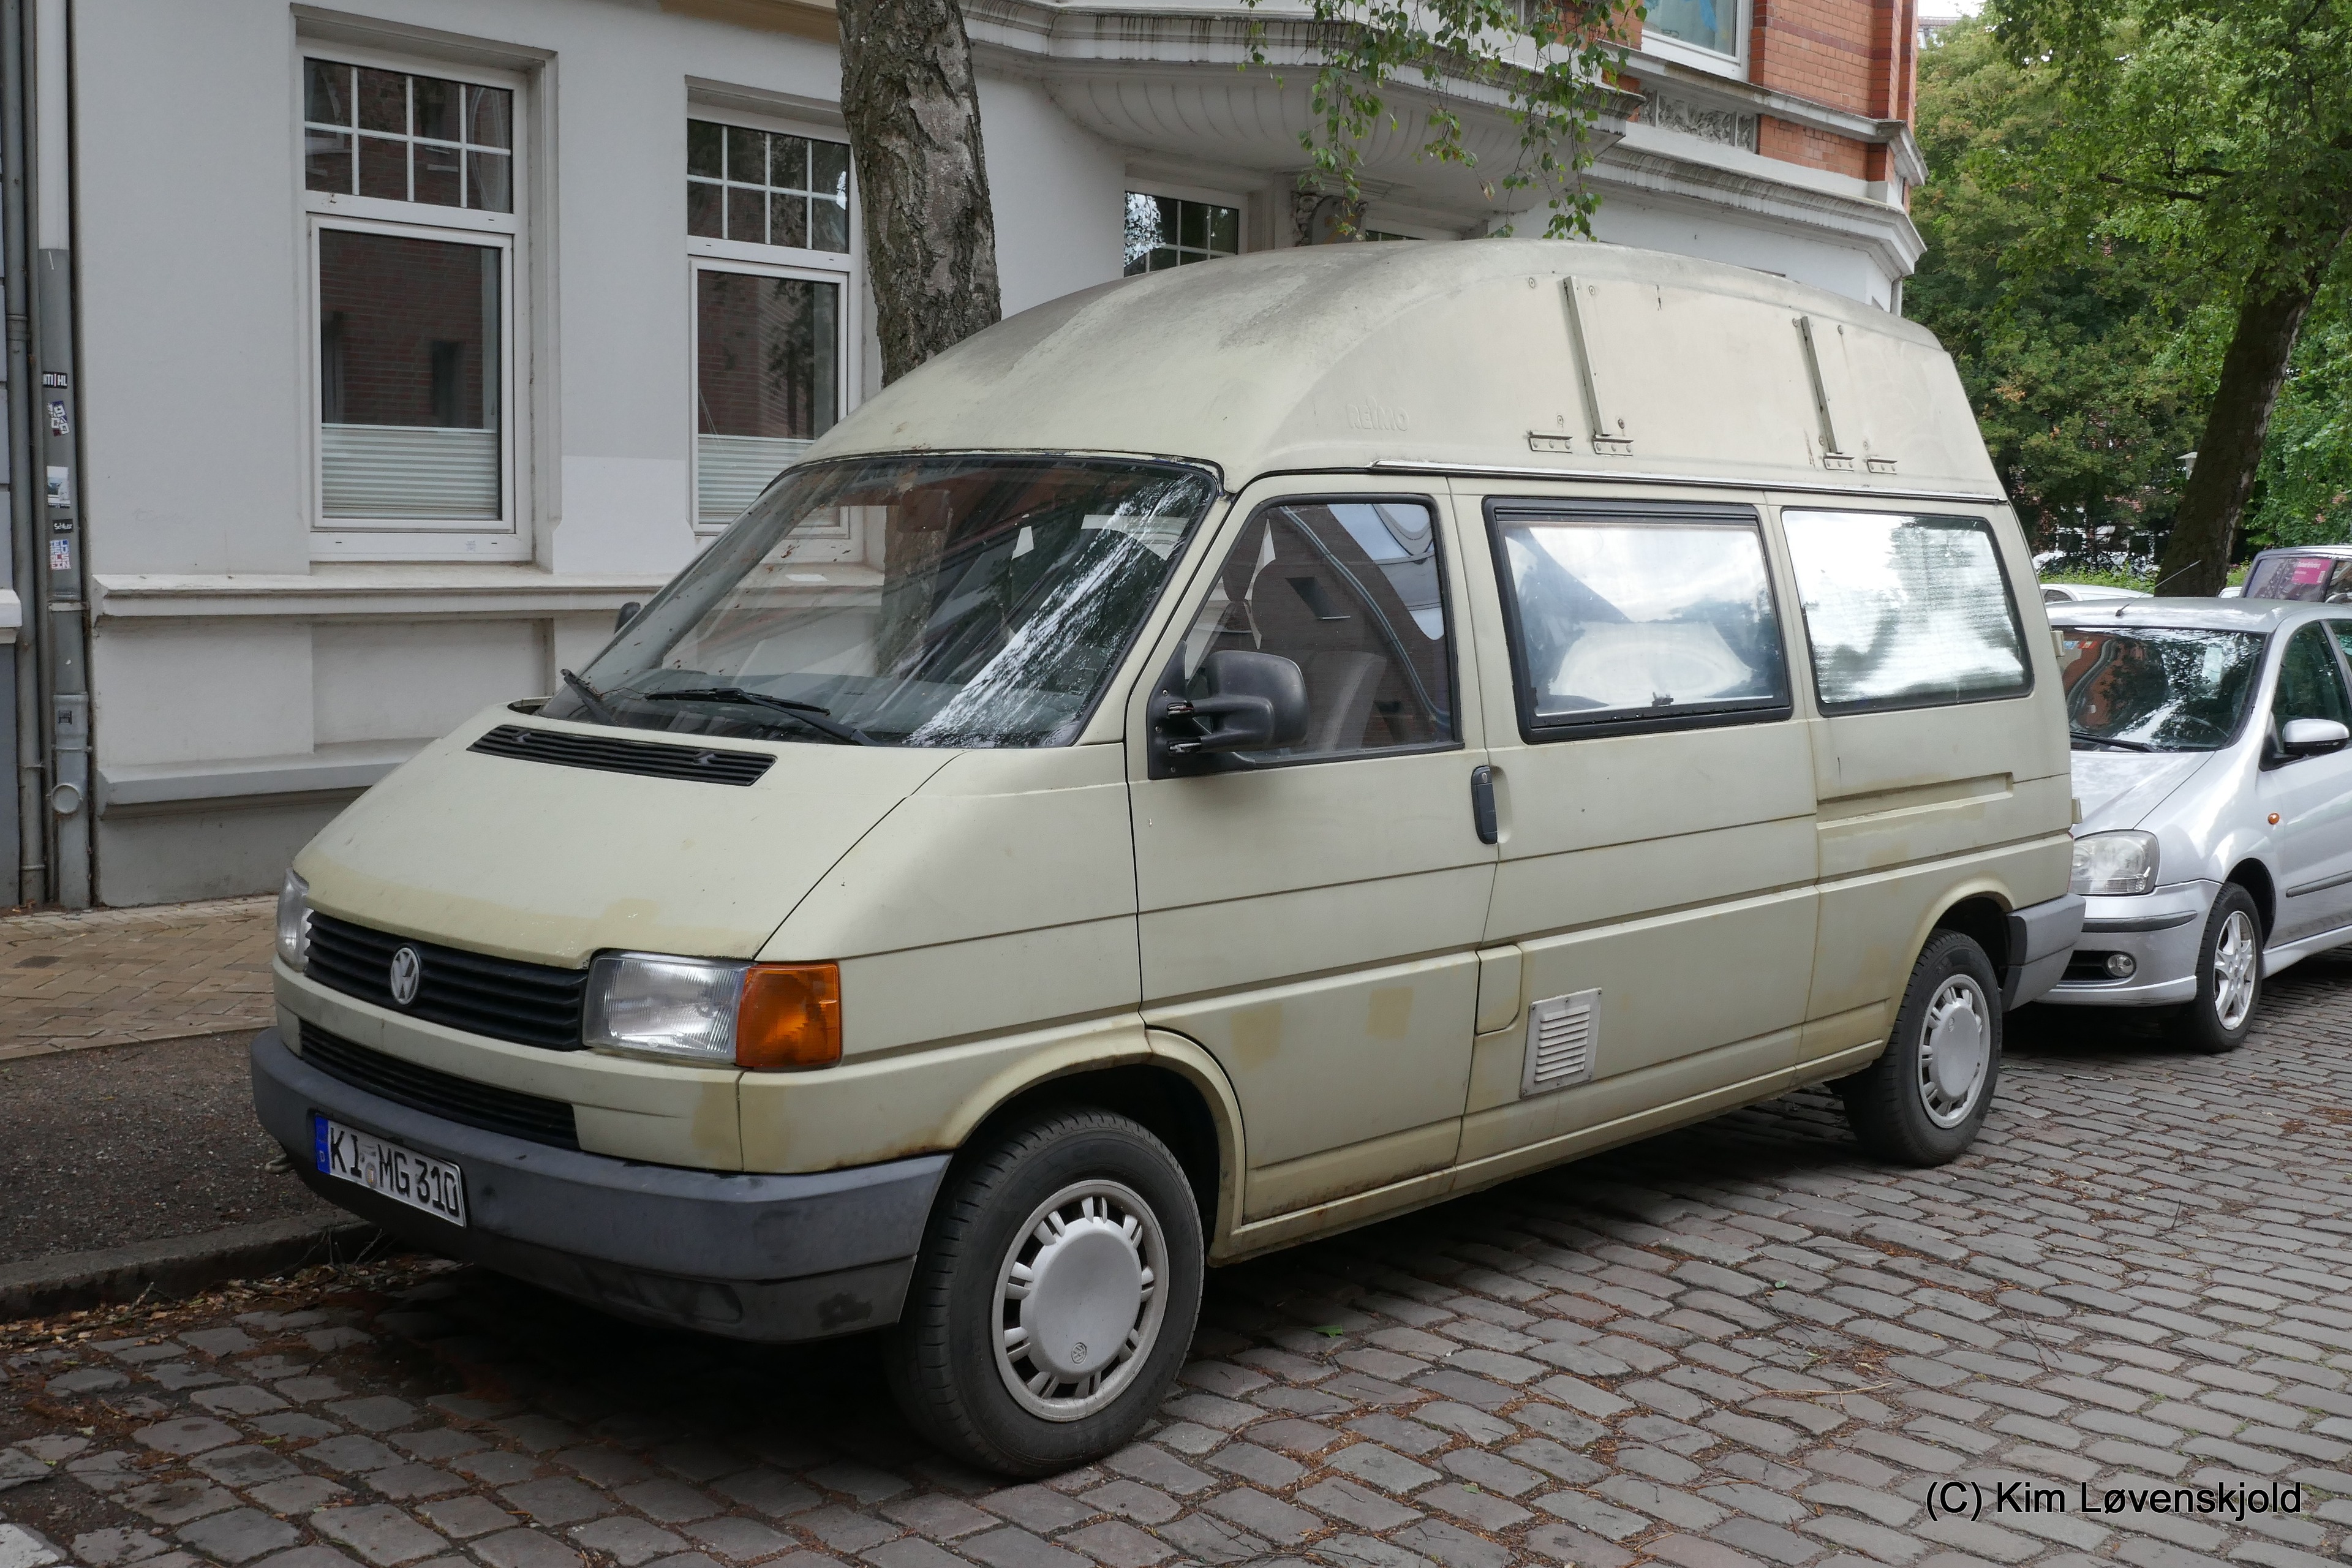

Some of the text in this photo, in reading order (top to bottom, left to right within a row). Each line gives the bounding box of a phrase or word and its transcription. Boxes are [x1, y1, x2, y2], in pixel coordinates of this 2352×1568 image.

[330, 1127, 362, 1178] KI
[377, 1144, 410, 1198] MG
[415, 1158, 459, 1218] 310
